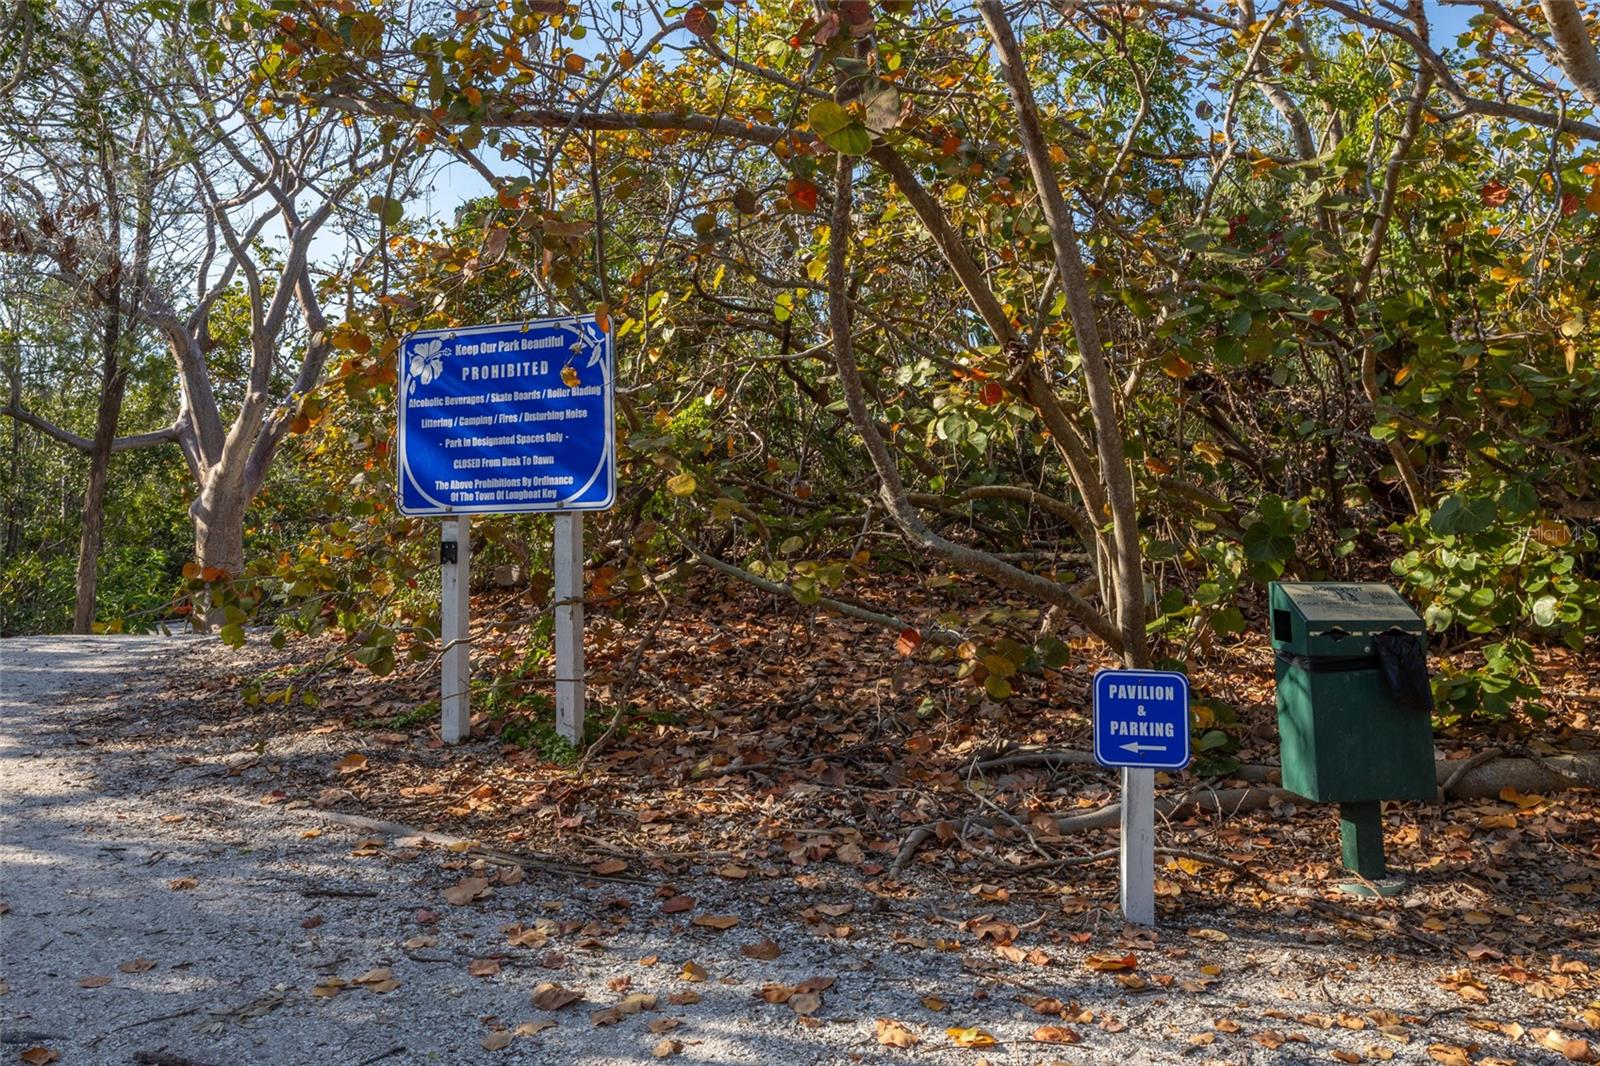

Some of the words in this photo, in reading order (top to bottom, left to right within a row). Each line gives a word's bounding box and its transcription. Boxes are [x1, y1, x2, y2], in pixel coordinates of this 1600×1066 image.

[455, 343, 478, 356] Keep
[481, 341, 497, 353] Our
[498, 339, 519, 353] Park
[521, 335, 563, 350] Beautiful
[462, 361, 548, 381] PROHIBITED
[409, 396, 443, 408] Alcoholic
[445, 394, 484, 406] Beverages
[491, 393, 512, 402] Skate
[514, 390, 540, 400] Boards
[547, 388, 570, 398] Roller
[572, 386, 601, 397] Blading
[421, 418, 452, 428] Littering
[459, 415, 492, 426] Camping
[499, 414, 518, 424] Fires
[524, 411, 564, 422] Disturbing
[566, 409, 587, 418] Noise
[445, 438, 462, 448] Park
[464, 437, 471, 447] In
[472, 435, 514, 446] Designated
[517, 433, 544, 444] Spaces
[546, 432, 562, 443] Only
[453, 459, 480, 468] CLOSED
[482, 458, 500, 467] From
[502, 457, 520, 466] Dusk
[522, 456, 531, 465] To
[533, 456, 554, 464] Dawn
[435, 481, 449, 490] The
[450, 479, 473, 489] Above
[475, 478, 521, 488] Prohibitions
[522, 477, 531, 488] By
[533, 475, 573, 486] Ordinance
[451, 493, 459, 501] Of
[460, 492, 473, 501] The
[475, 492, 494, 500] Town
[496, 491, 504, 499] Of
[506, 490, 540, 500] Longboat
[542, 489, 556, 499] Key
[1109, 684, 1174, 700] PAVILION
[1137, 705, 1146, 716] &
[1110, 721, 1174, 737] PARKING
